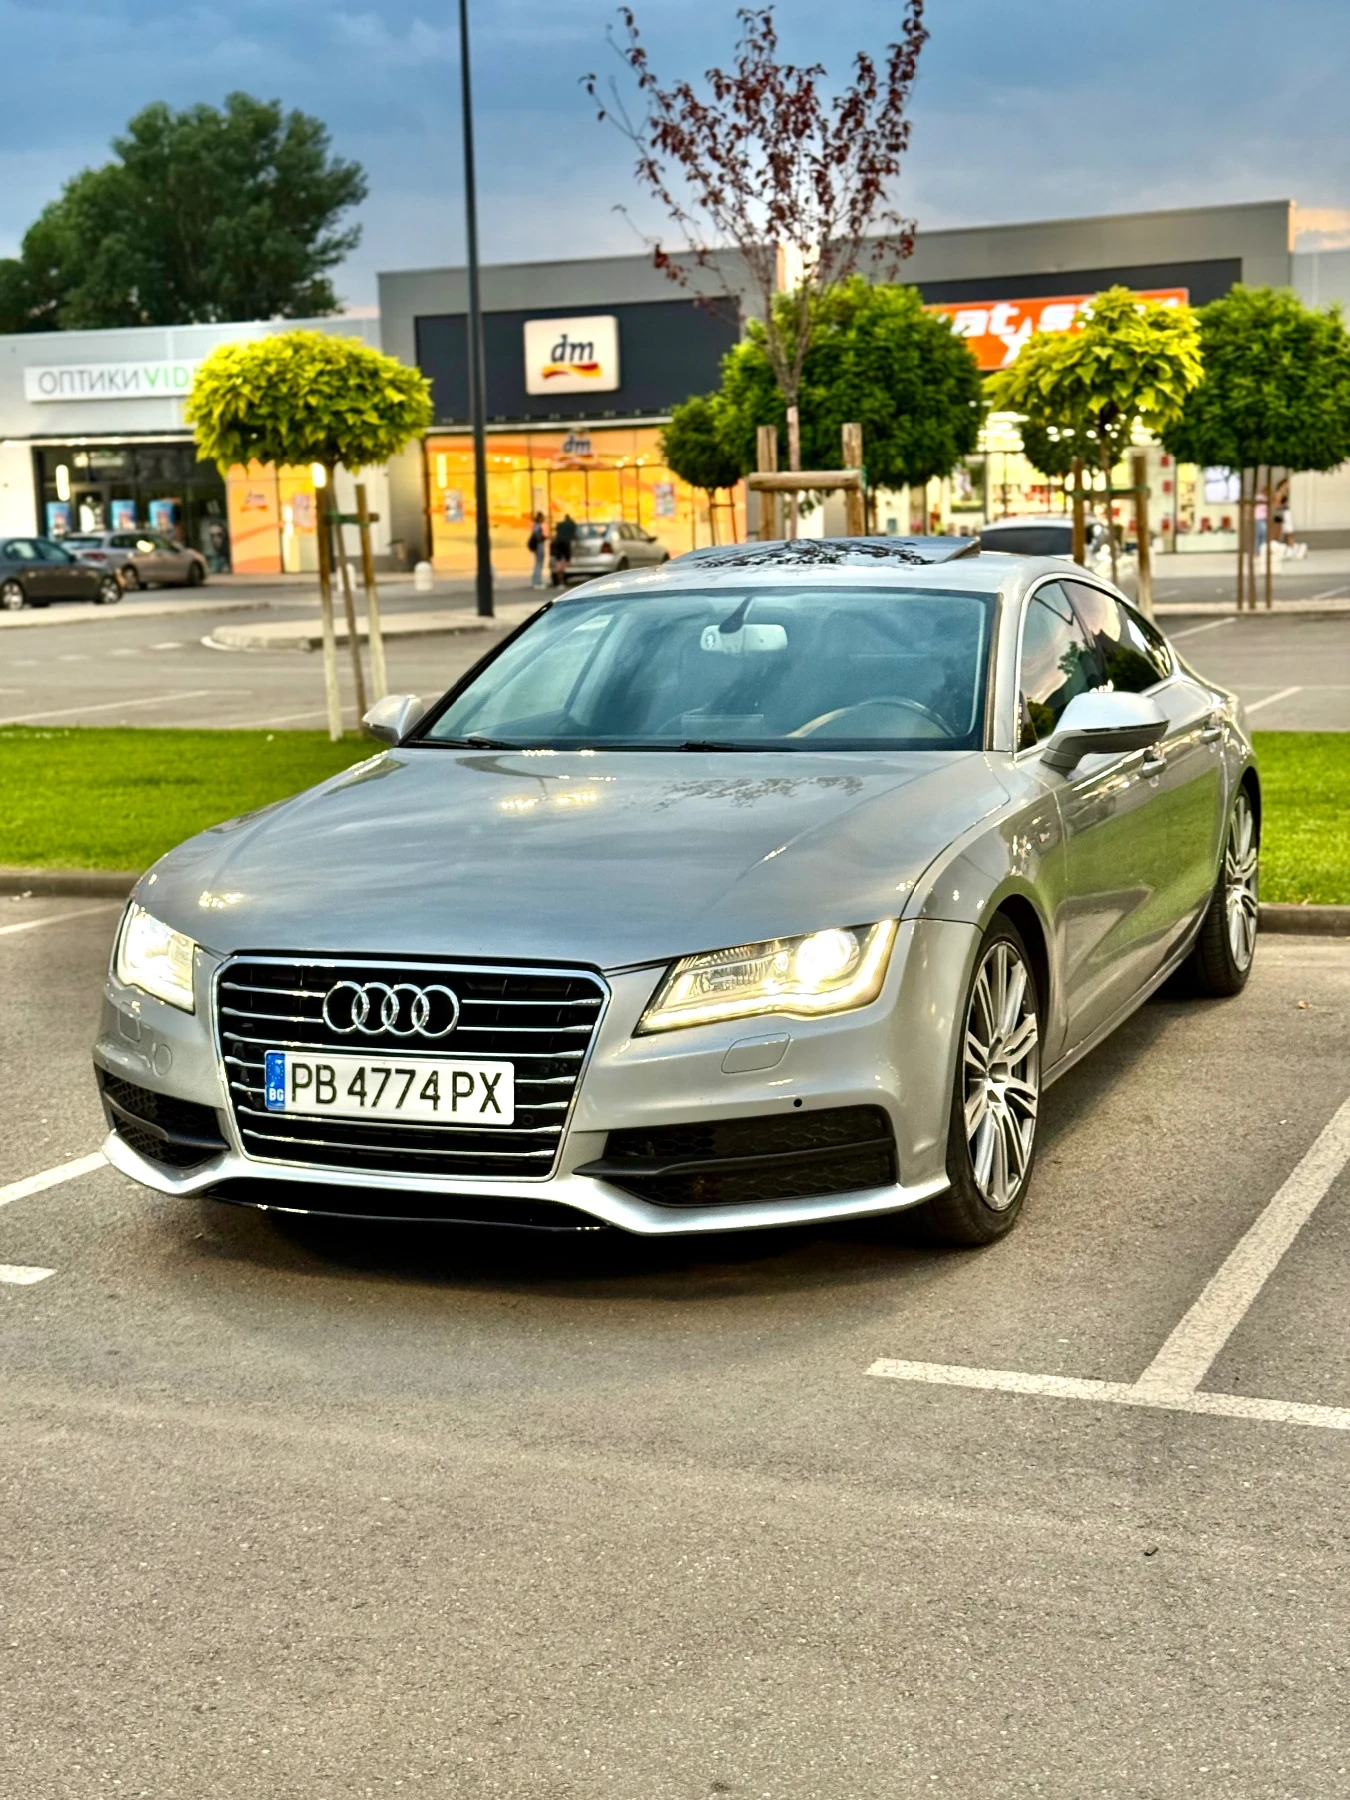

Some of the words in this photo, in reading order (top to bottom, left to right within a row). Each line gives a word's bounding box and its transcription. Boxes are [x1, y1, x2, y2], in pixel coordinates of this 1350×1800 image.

[551, 333, 594, 363] dm
[38, 367, 140, 394] ОПТИКИ
[144, 365, 200, 389] VID
[268, 1087, 284, 1102] BG
[291, 1062, 337, 1105] PB
[347, 1066, 441, 1111] 4774
[451, 1071, 502, 1114] PX
